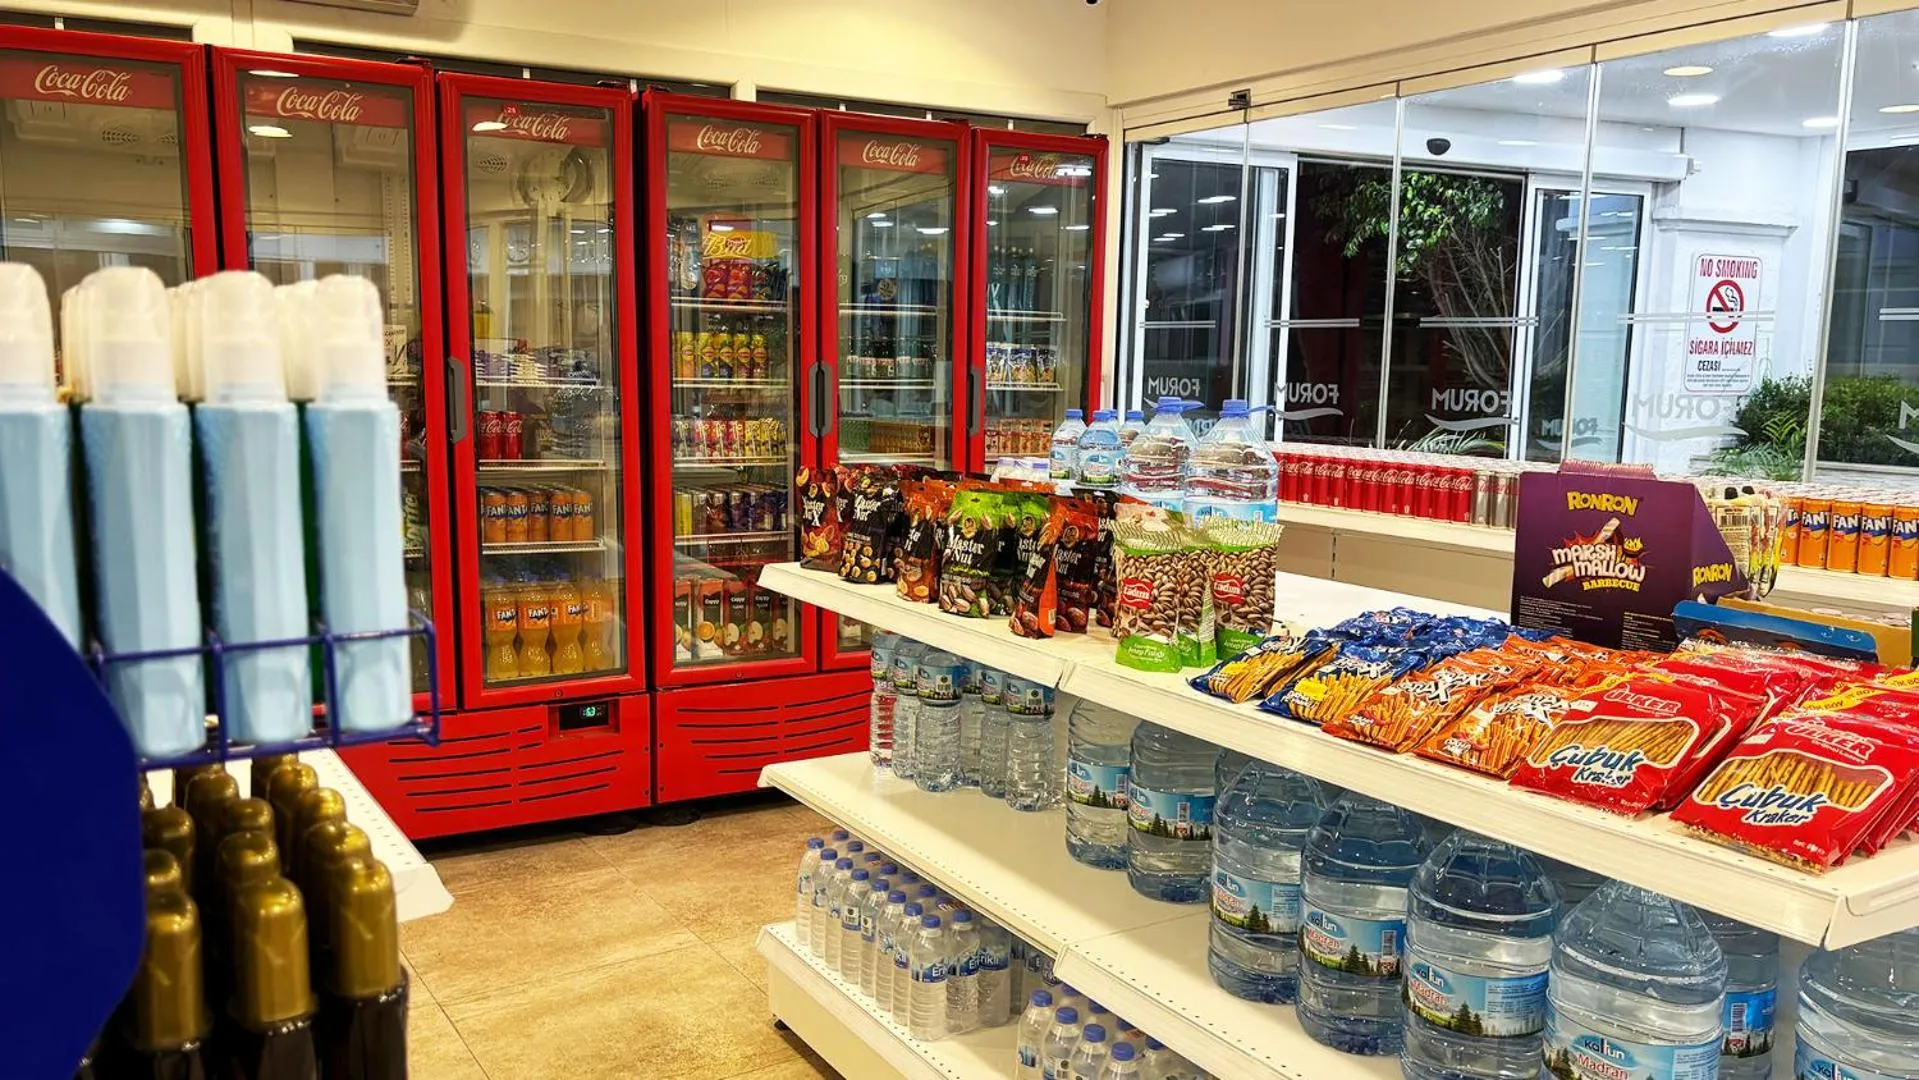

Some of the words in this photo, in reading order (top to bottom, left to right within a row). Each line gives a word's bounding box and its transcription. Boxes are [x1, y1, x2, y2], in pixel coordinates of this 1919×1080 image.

[35, 64, 133, 101] Coca-Cola
[277, 86, 363, 121] Coca-Cola
[697, 124, 761, 154] Coca-Cola
[862, 139, 921, 167] Coca-Cola
[1700, 258, 1714, 277] NO
[1715, 259, 1758, 279] SMOKING
[1689, 337, 1719, 355] SİGARA
[1720, 338, 1753, 358] İÇİLMEZ
[1697, 360, 1721, 372] CEZASI
[486, 505, 506, 516] FAN
[530, 503, 547, 513] FAN
[1567, 491, 1639, 516] RONRON
[1801, 510, 1830, 528] FANT
[1832, 514, 1860, 529] FAN
[1861, 516, 1893, 531] FANT
[1892, 518, 1919, 535] FAN
[947, 526, 985, 555] Master
[952, 547, 972, 565] Nut
[1582, 578, 1641, 592] BARBECUE
[1692, 562, 1733, 589] RONRON
[1549, 745, 1645, 772] Çubuk
[1720, 783, 1827, 813] Çubuk
[1744, 809, 1810, 824] Kraker
[1577, 1053, 1630, 1080] Madran
